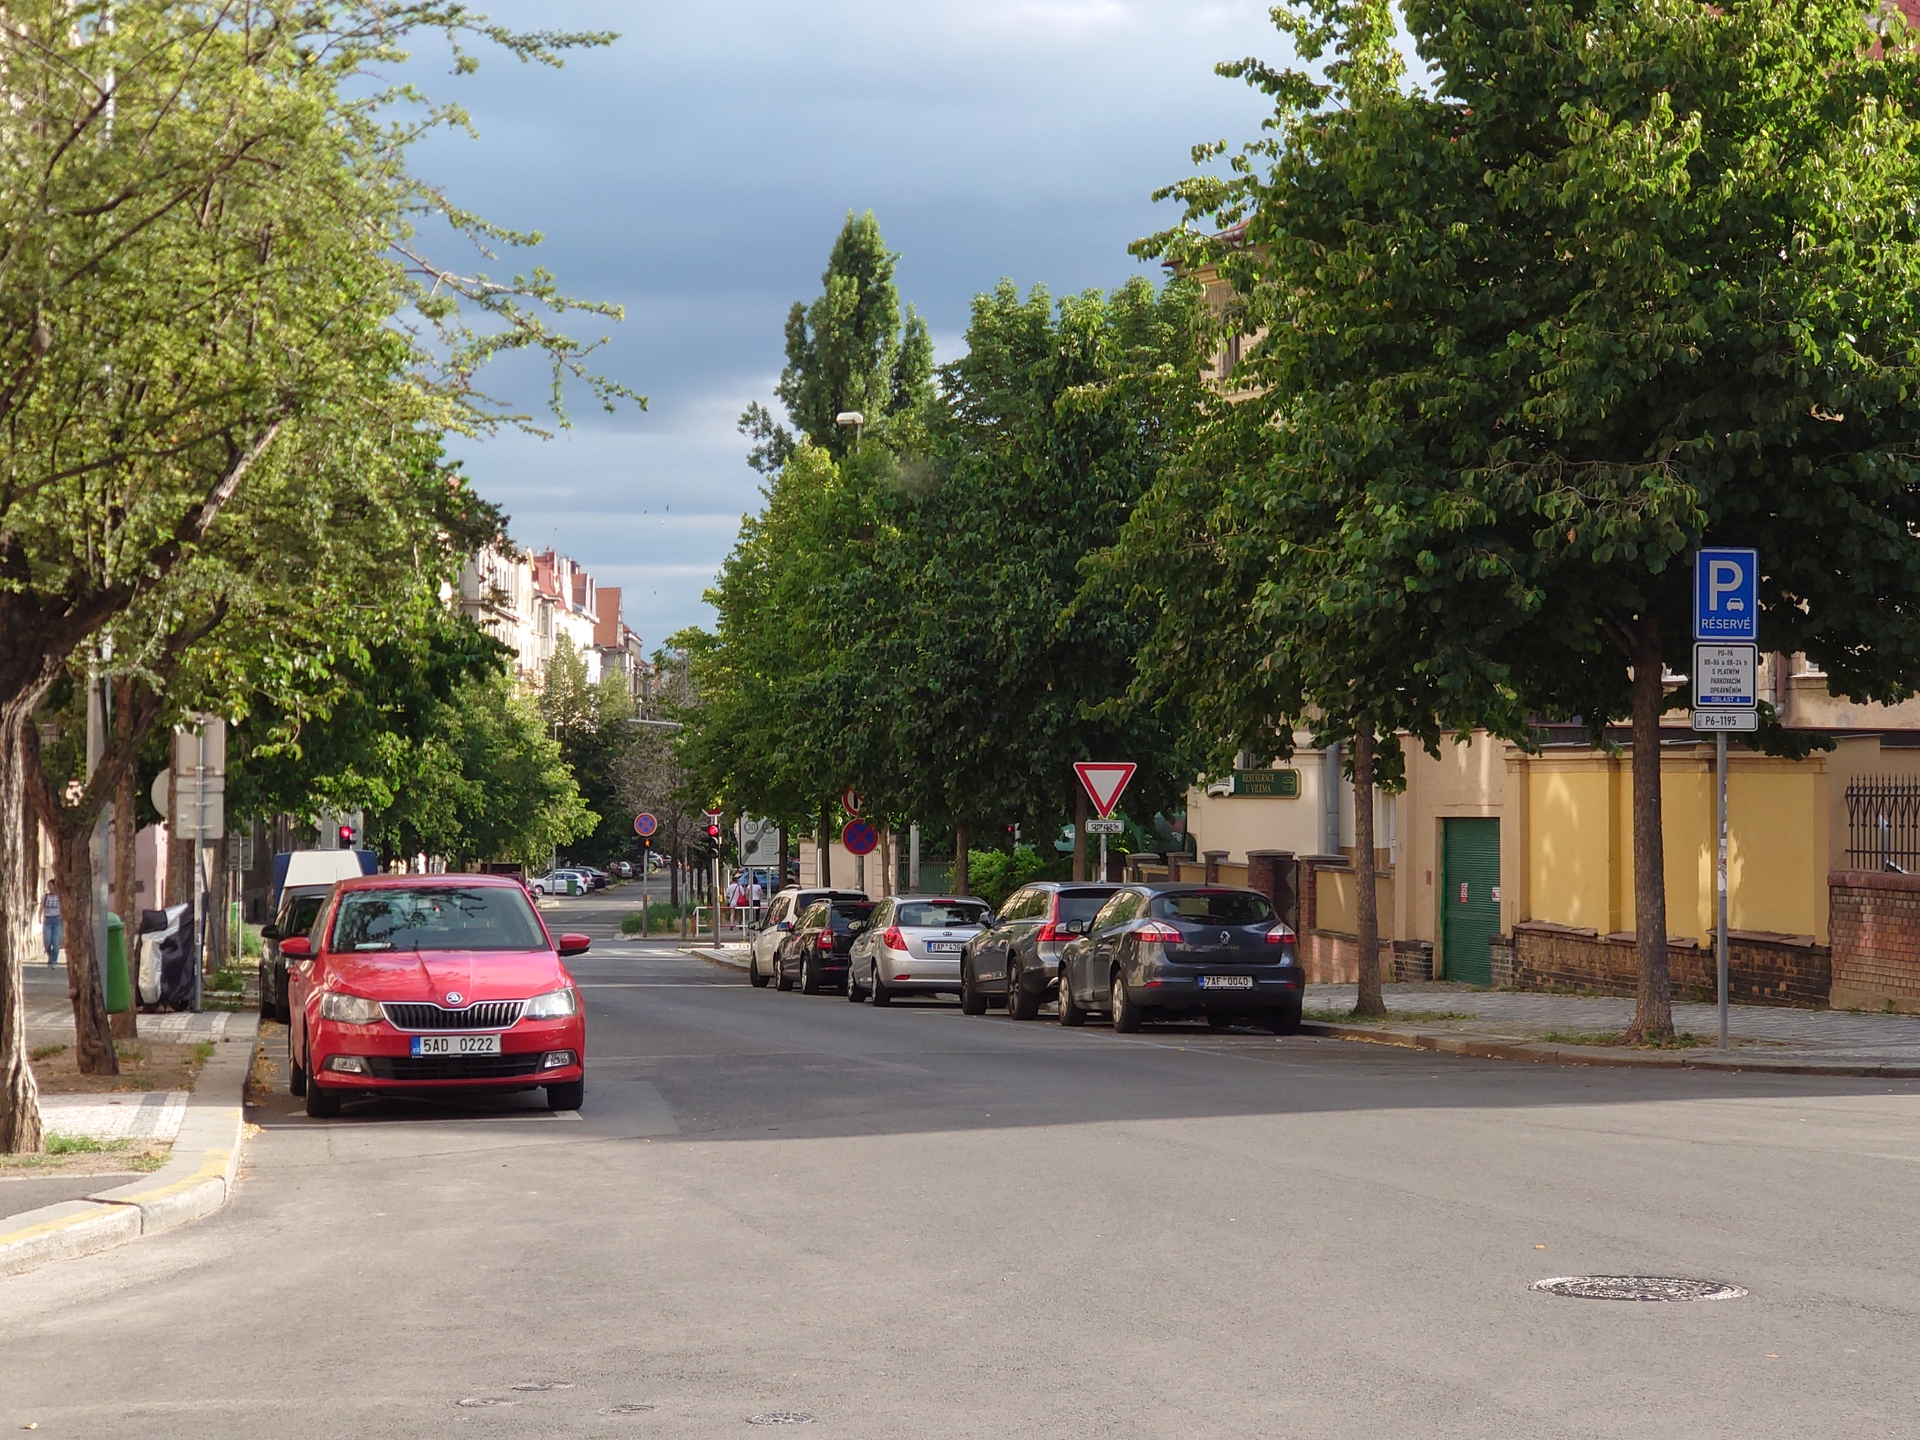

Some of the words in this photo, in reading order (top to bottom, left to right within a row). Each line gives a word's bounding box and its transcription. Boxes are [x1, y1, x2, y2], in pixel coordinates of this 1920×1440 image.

[1709, 560, 1744, 611] P
[1701, 616, 1751, 630] RÉSERVÉ
[1718, 649, 1734, 657] PO-PÁ
[1717, 667, 1740, 675] PLATNÝM
[1705, 716, 1737, 726] P6-1195
[1242, 773, 1275, 783] RESTAURACE
[1245, 784, 1250, 793] U
[932, 943, 945, 951] 6AP
[1205, 976, 1221, 986] 7AF
[1227, 976, 1249, 986] 0040
[423, 1038, 449, 1053] 5AD
[460, 1037, 493, 1052] 0222
